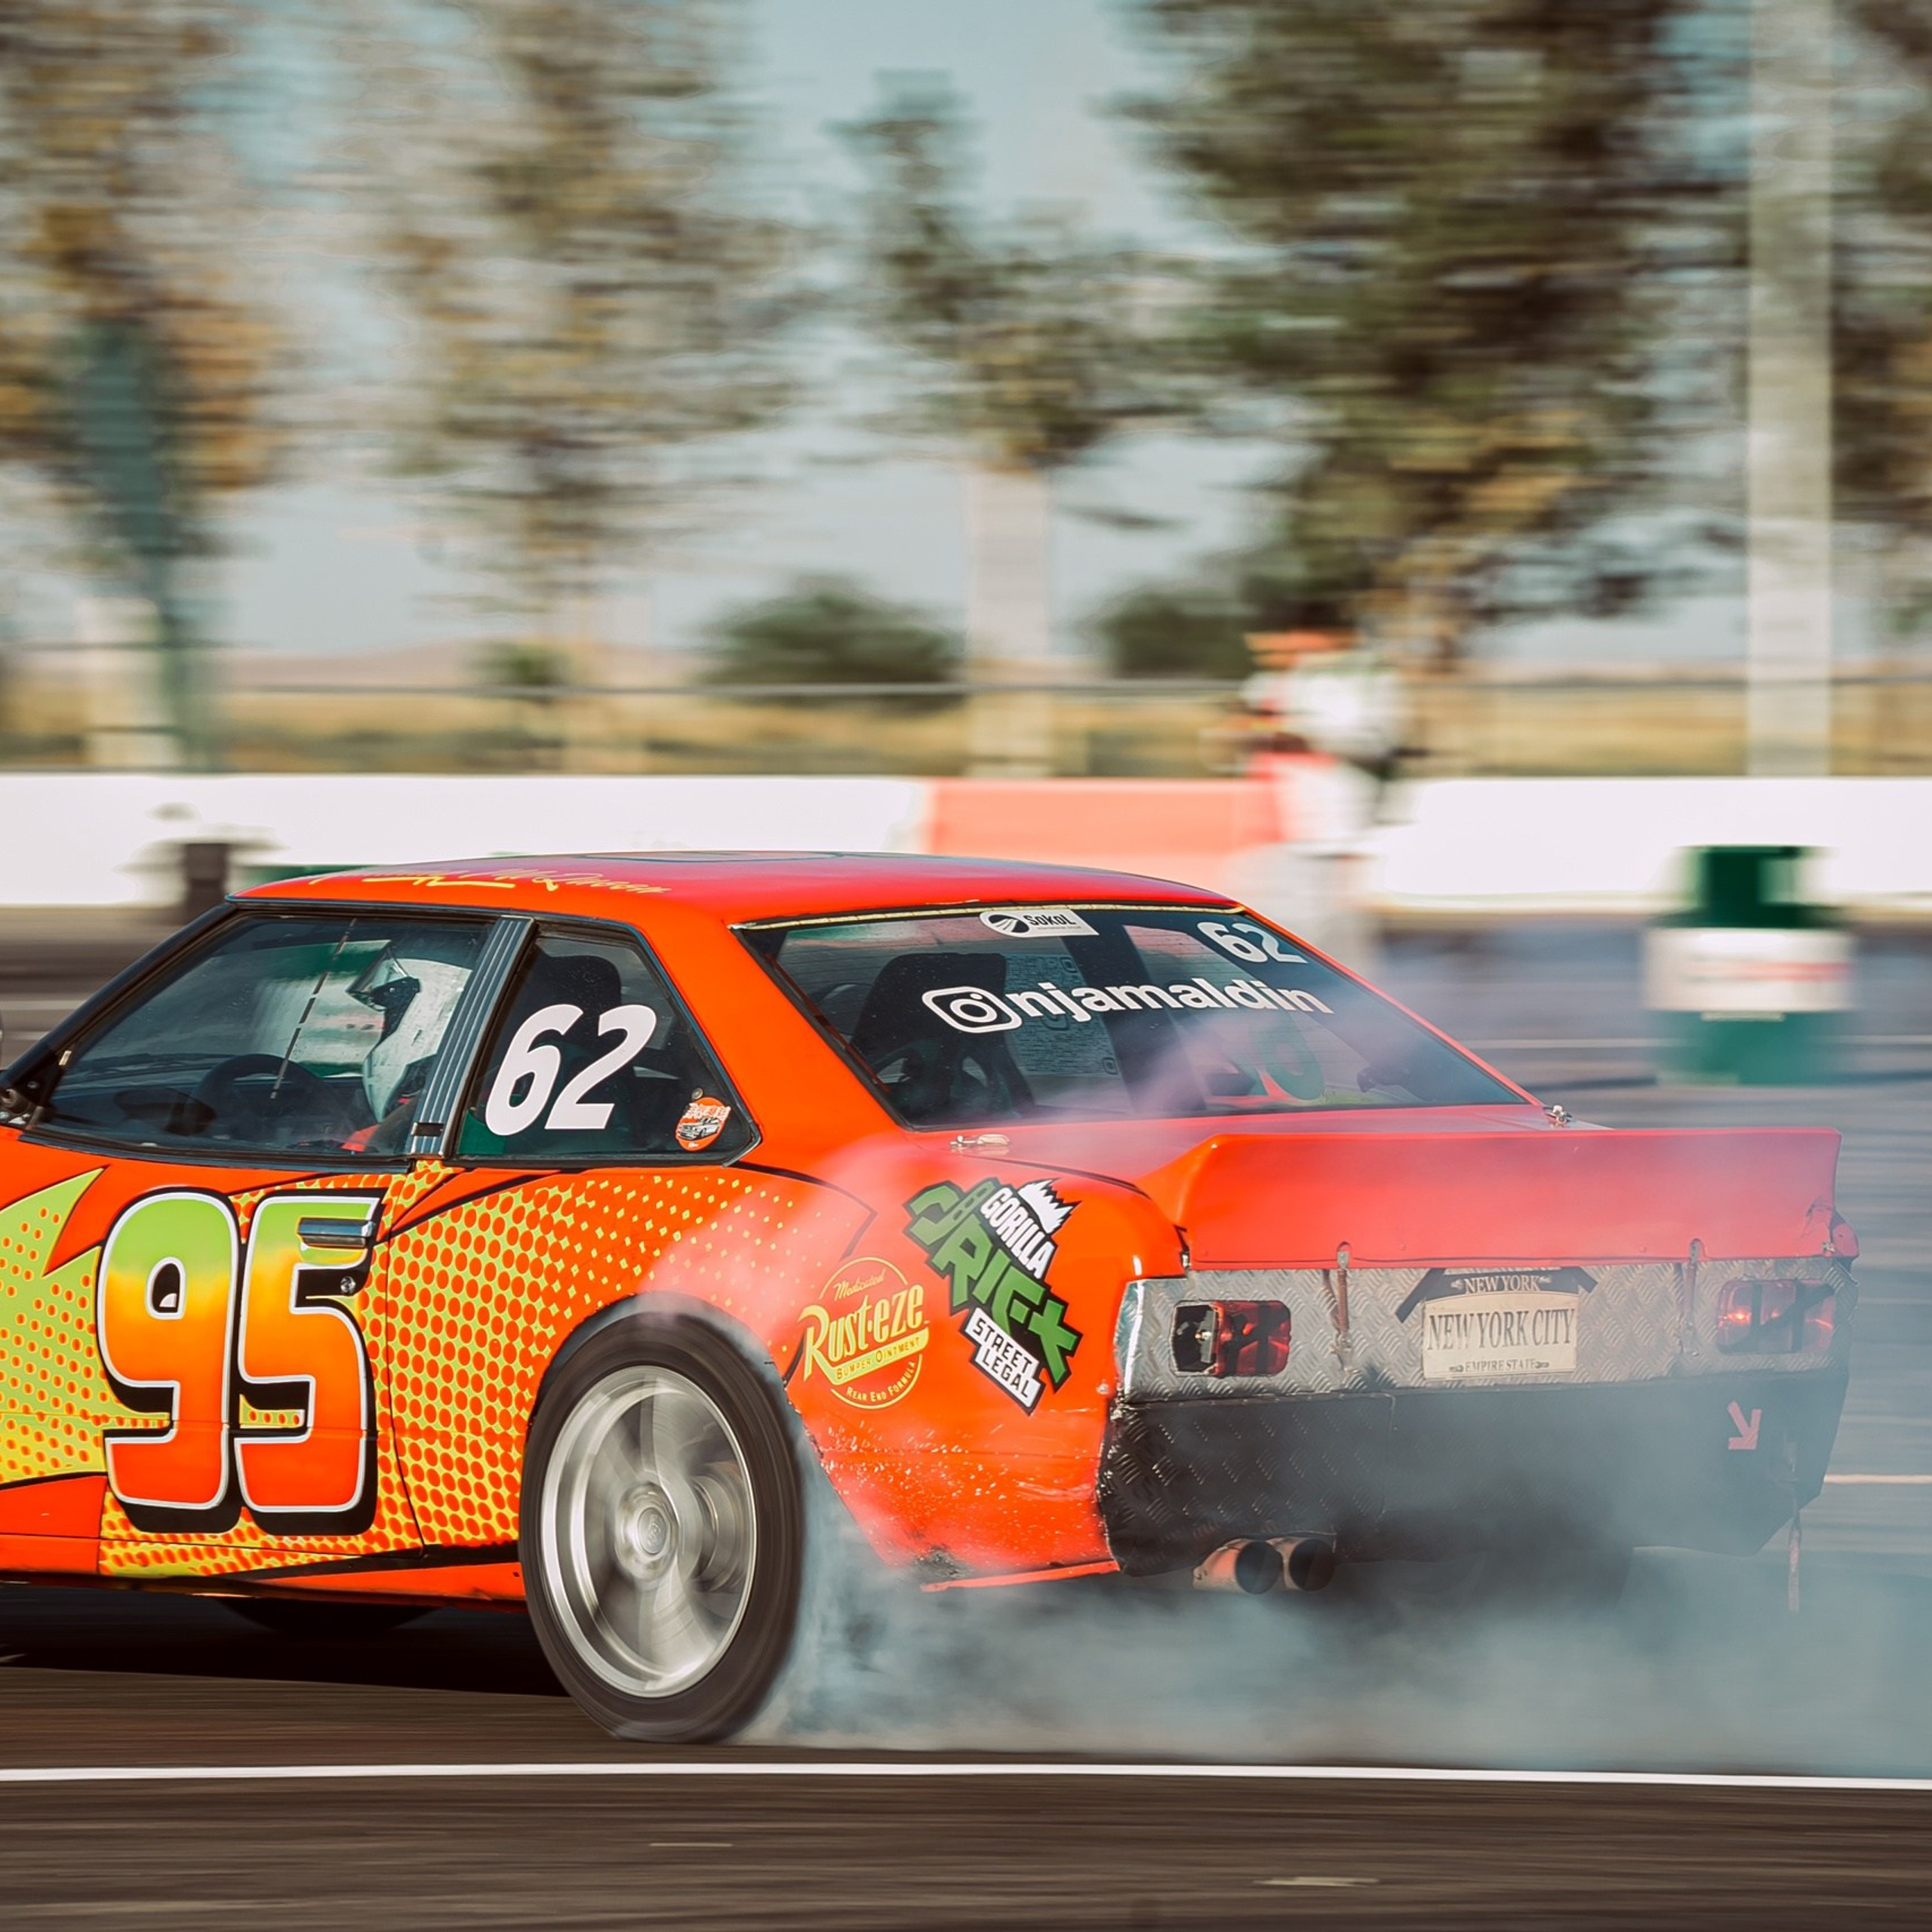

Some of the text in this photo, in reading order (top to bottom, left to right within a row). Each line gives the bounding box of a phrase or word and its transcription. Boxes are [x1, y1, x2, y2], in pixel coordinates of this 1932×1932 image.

[1197, 921, 1309, 964] 62
[1005, 977, 1334, 1023] njamaldin
[485, 1003, 657, 1137] 62
[981, 1187, 1054, 1279] GORILLA
[833, 1268, 886, 1301] Medicated
[1464, 1274, 1542, 1294] NEW YORK
[973, 1319, 1032, 1375] STREET
[1427, 1308, 1576, 1351] NEW YORK CITY
[95, 1187, 383, 1537] 95
[983, 1348, 1032, 1398] LEGAL
[1466, 1358, 1537, 1373] EMPIRE STATE
